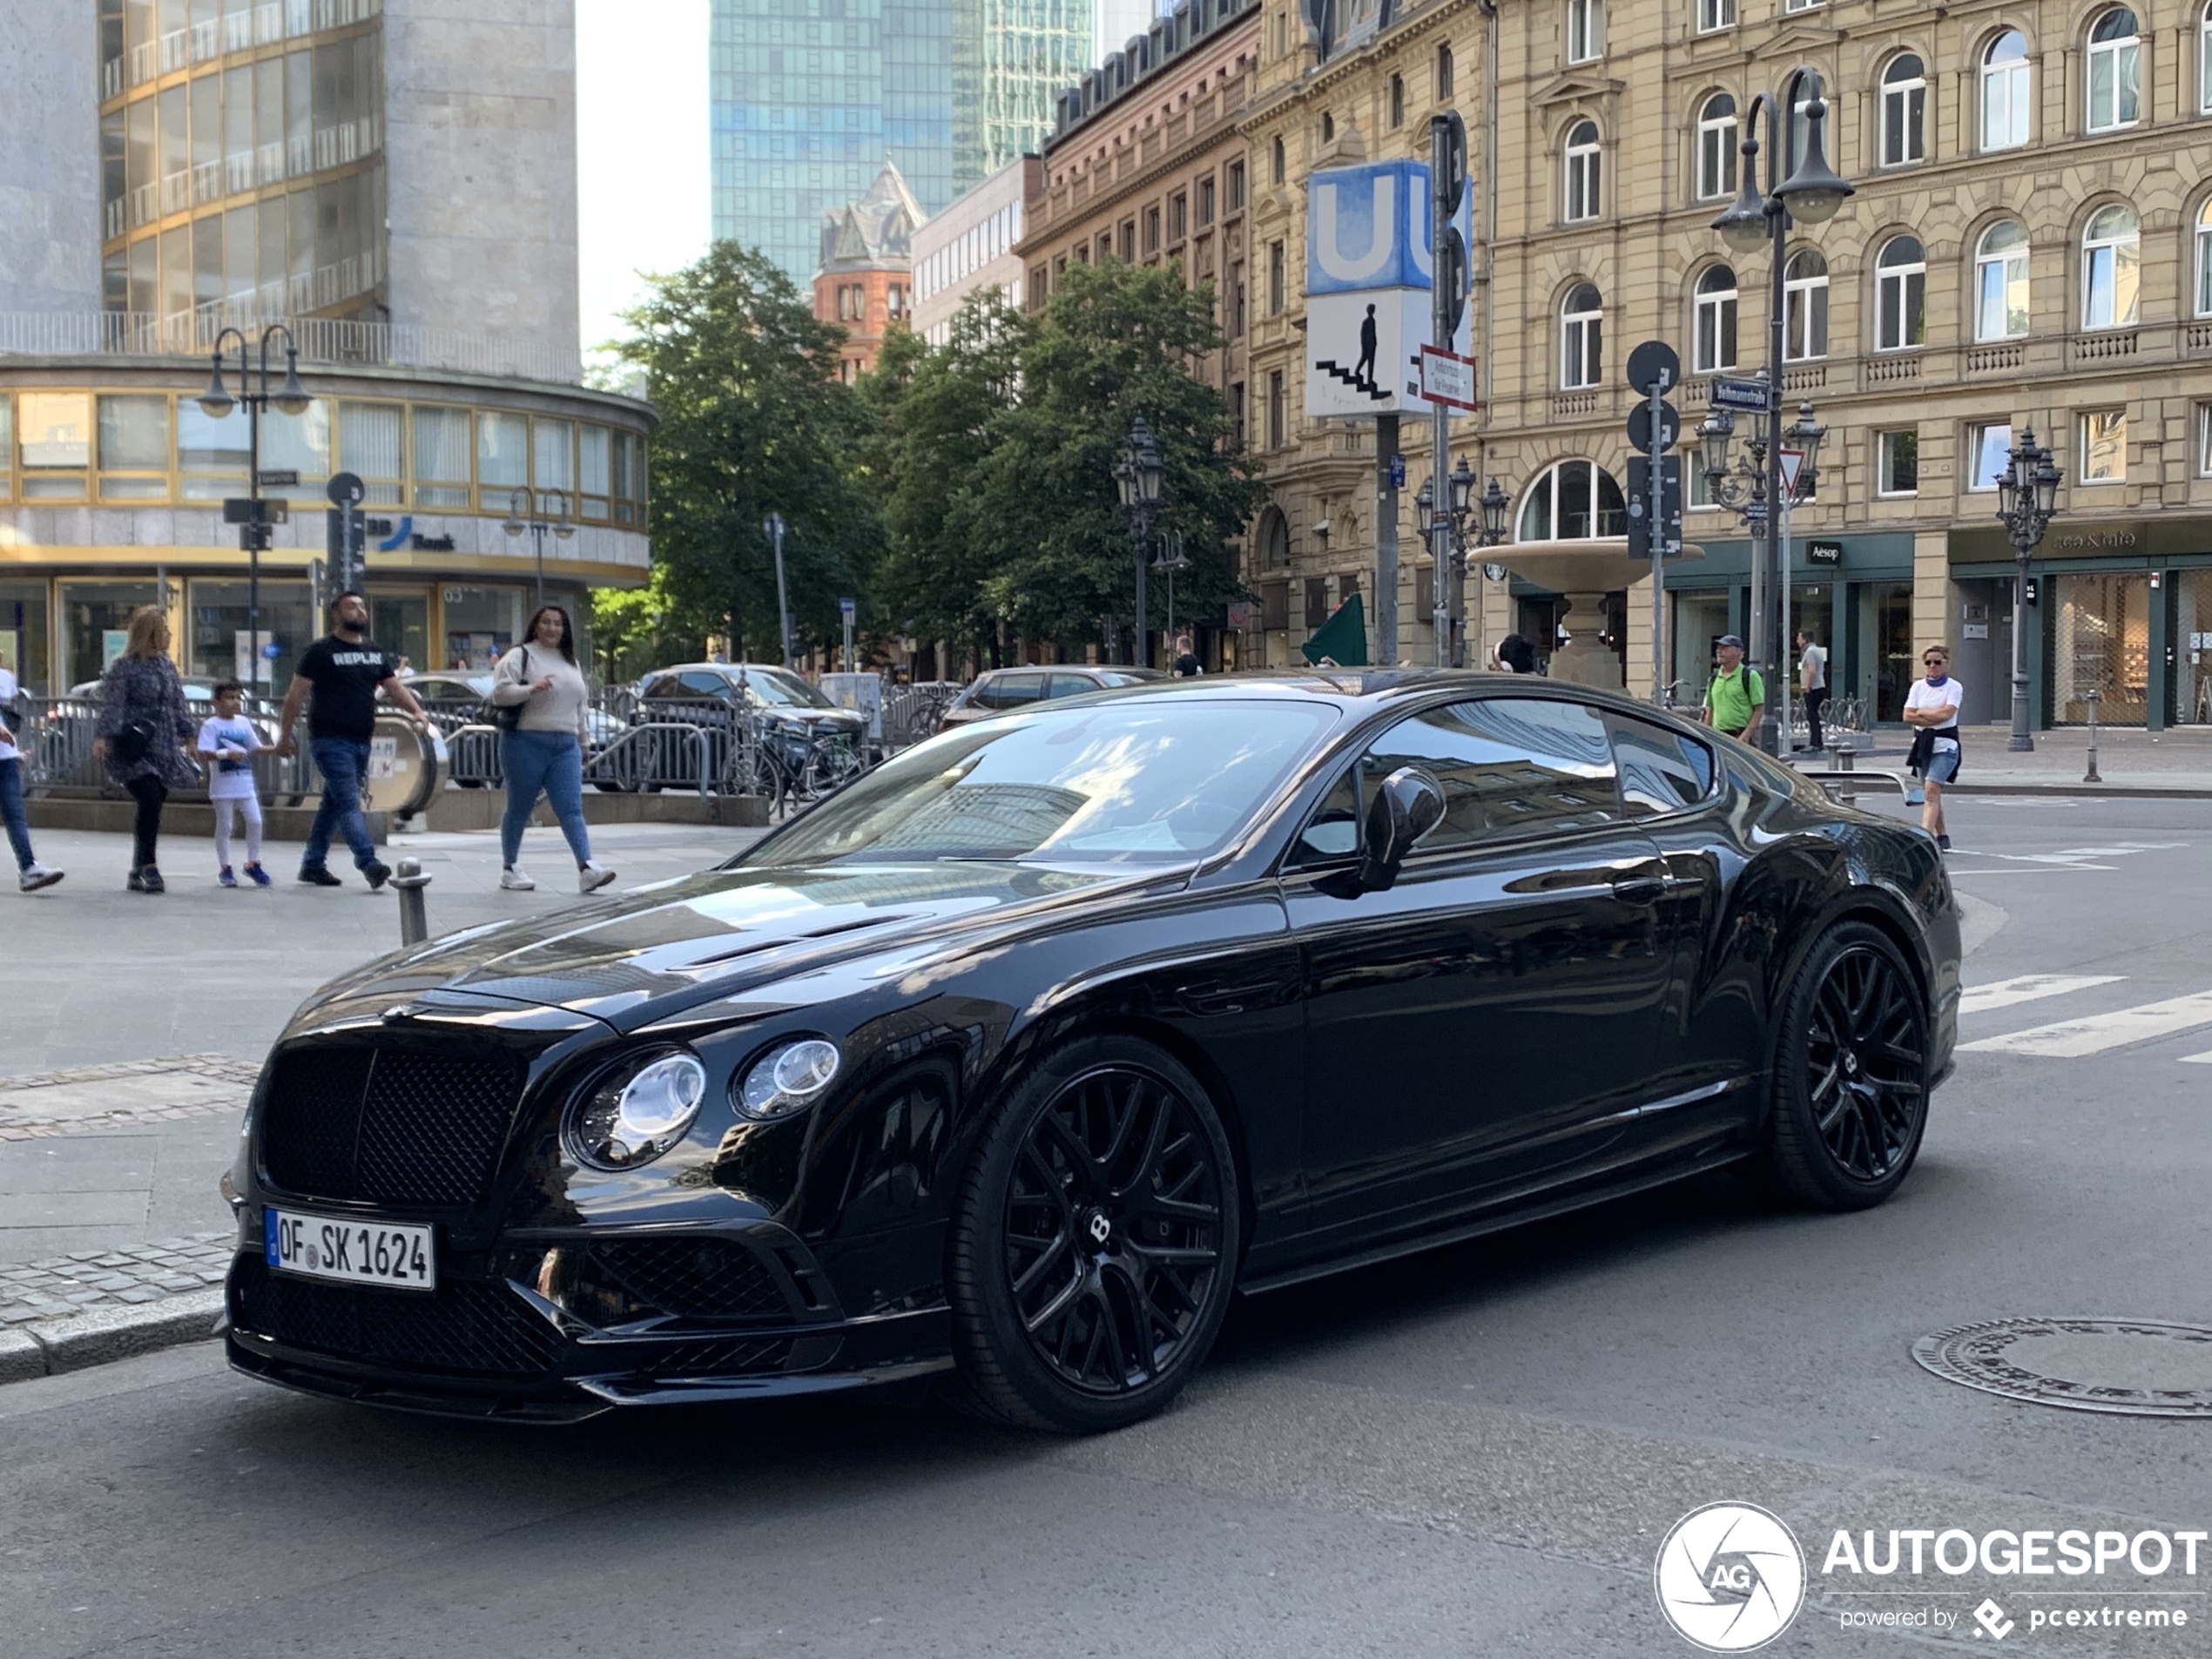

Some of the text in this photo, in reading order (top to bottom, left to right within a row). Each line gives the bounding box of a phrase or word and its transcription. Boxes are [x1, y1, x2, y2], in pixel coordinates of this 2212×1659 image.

[1317, 175, 1394, 280] U
[413, 534, 454, 550] Bank
[333, 651, 382, 665] REPLAY
[280, 1217, 427, 1280] OF SK 1624
